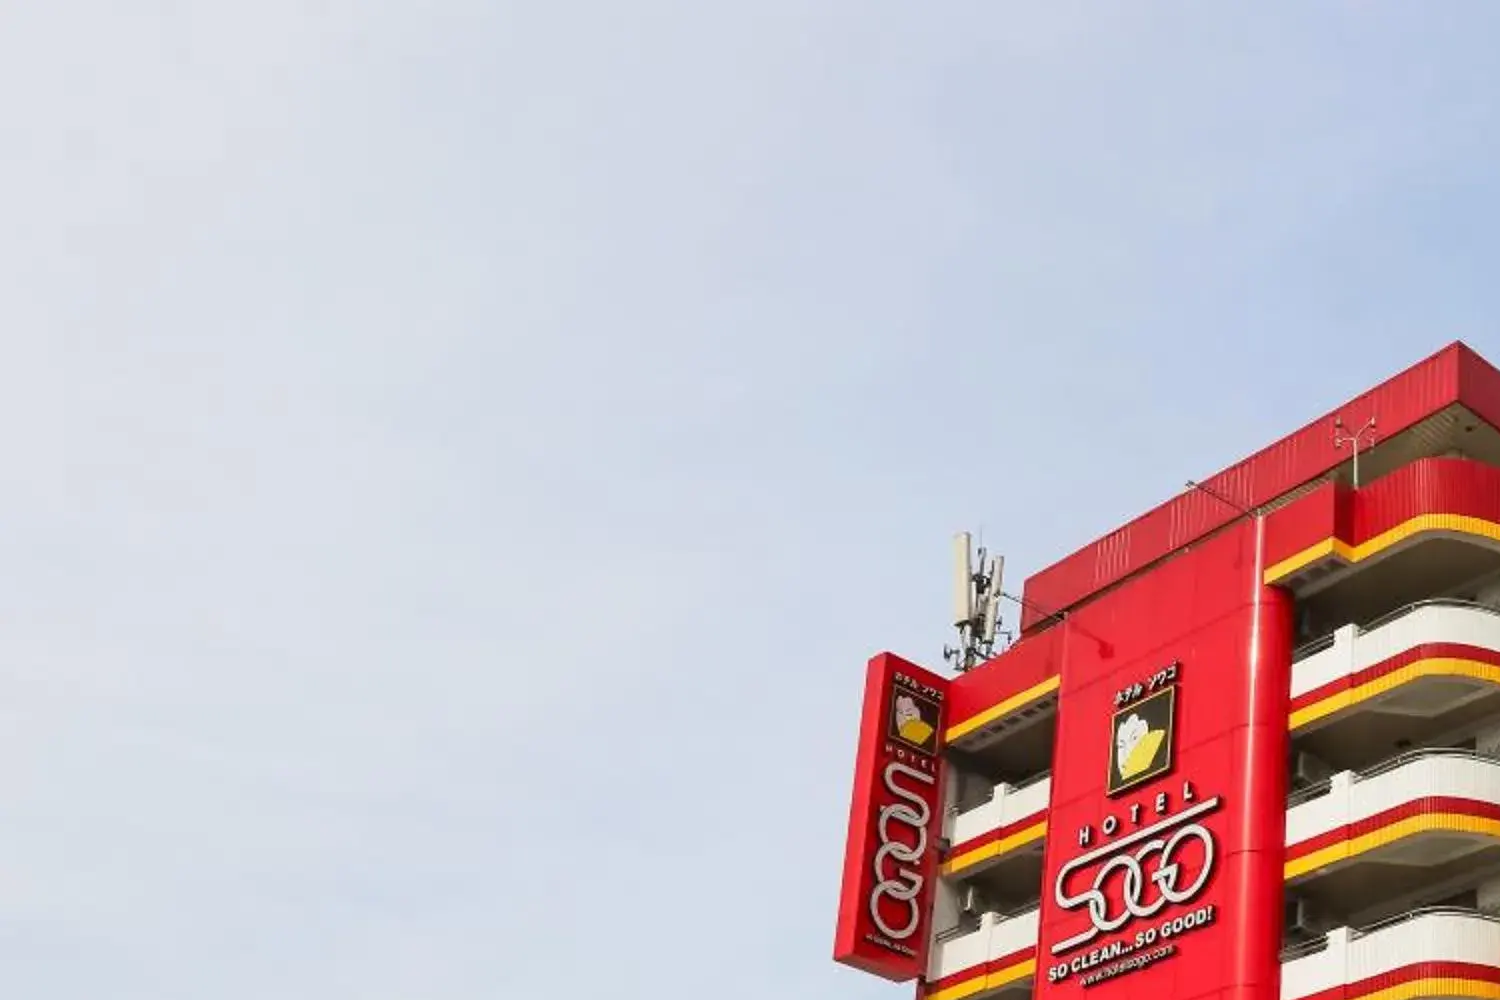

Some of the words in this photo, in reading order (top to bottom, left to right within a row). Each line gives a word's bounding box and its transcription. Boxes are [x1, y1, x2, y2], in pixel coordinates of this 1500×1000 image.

[1078, 780, 1195, 847] HOTEL
[1050, 796, 1220, 955] SOGO
[1048, 960, 1068, 982] SO
[1135, 927, 1157, 949] SO
[1160, 905, 1214, 937] GOOD!
